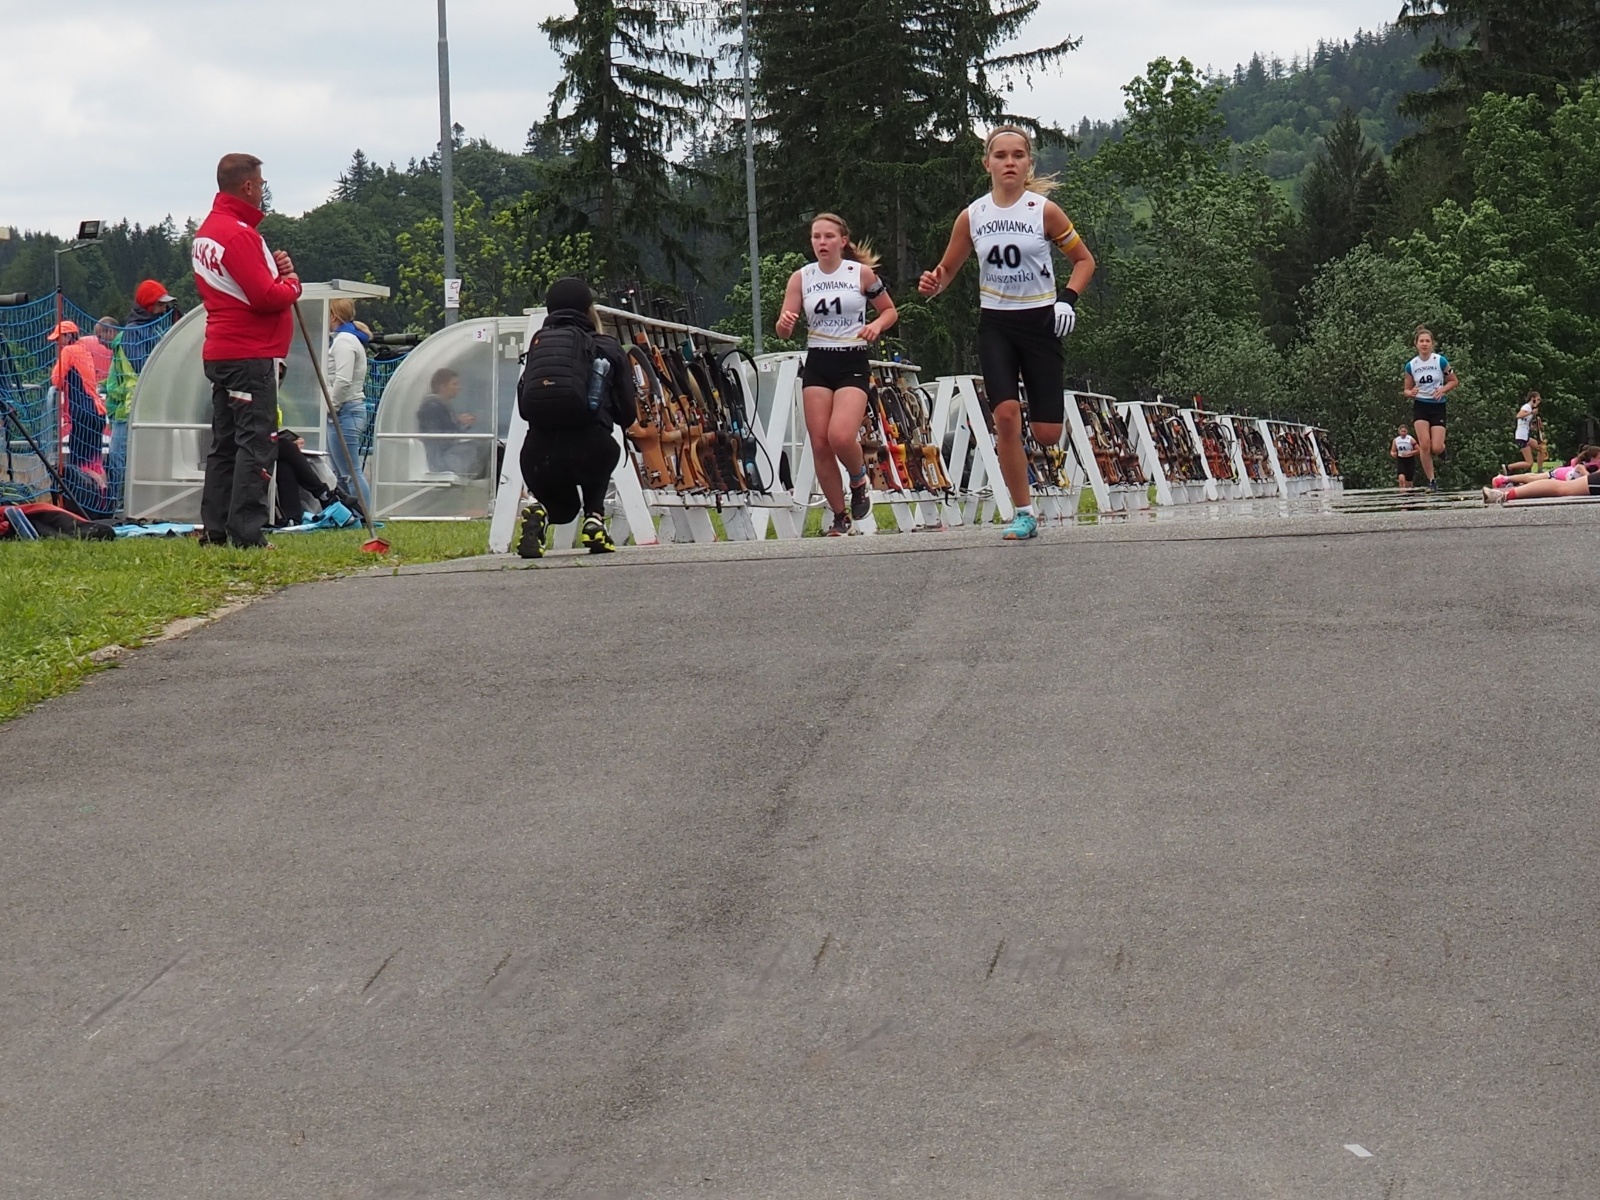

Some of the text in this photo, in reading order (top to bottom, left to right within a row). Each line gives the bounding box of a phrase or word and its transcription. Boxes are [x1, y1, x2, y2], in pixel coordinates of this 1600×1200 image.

[976, 219, 1035, 236] WYSOWIANKA
[987, 244, 1021, 269] 40
[814, 297, 842, 316] 41
[1419, 374, 1434, 384] 48
